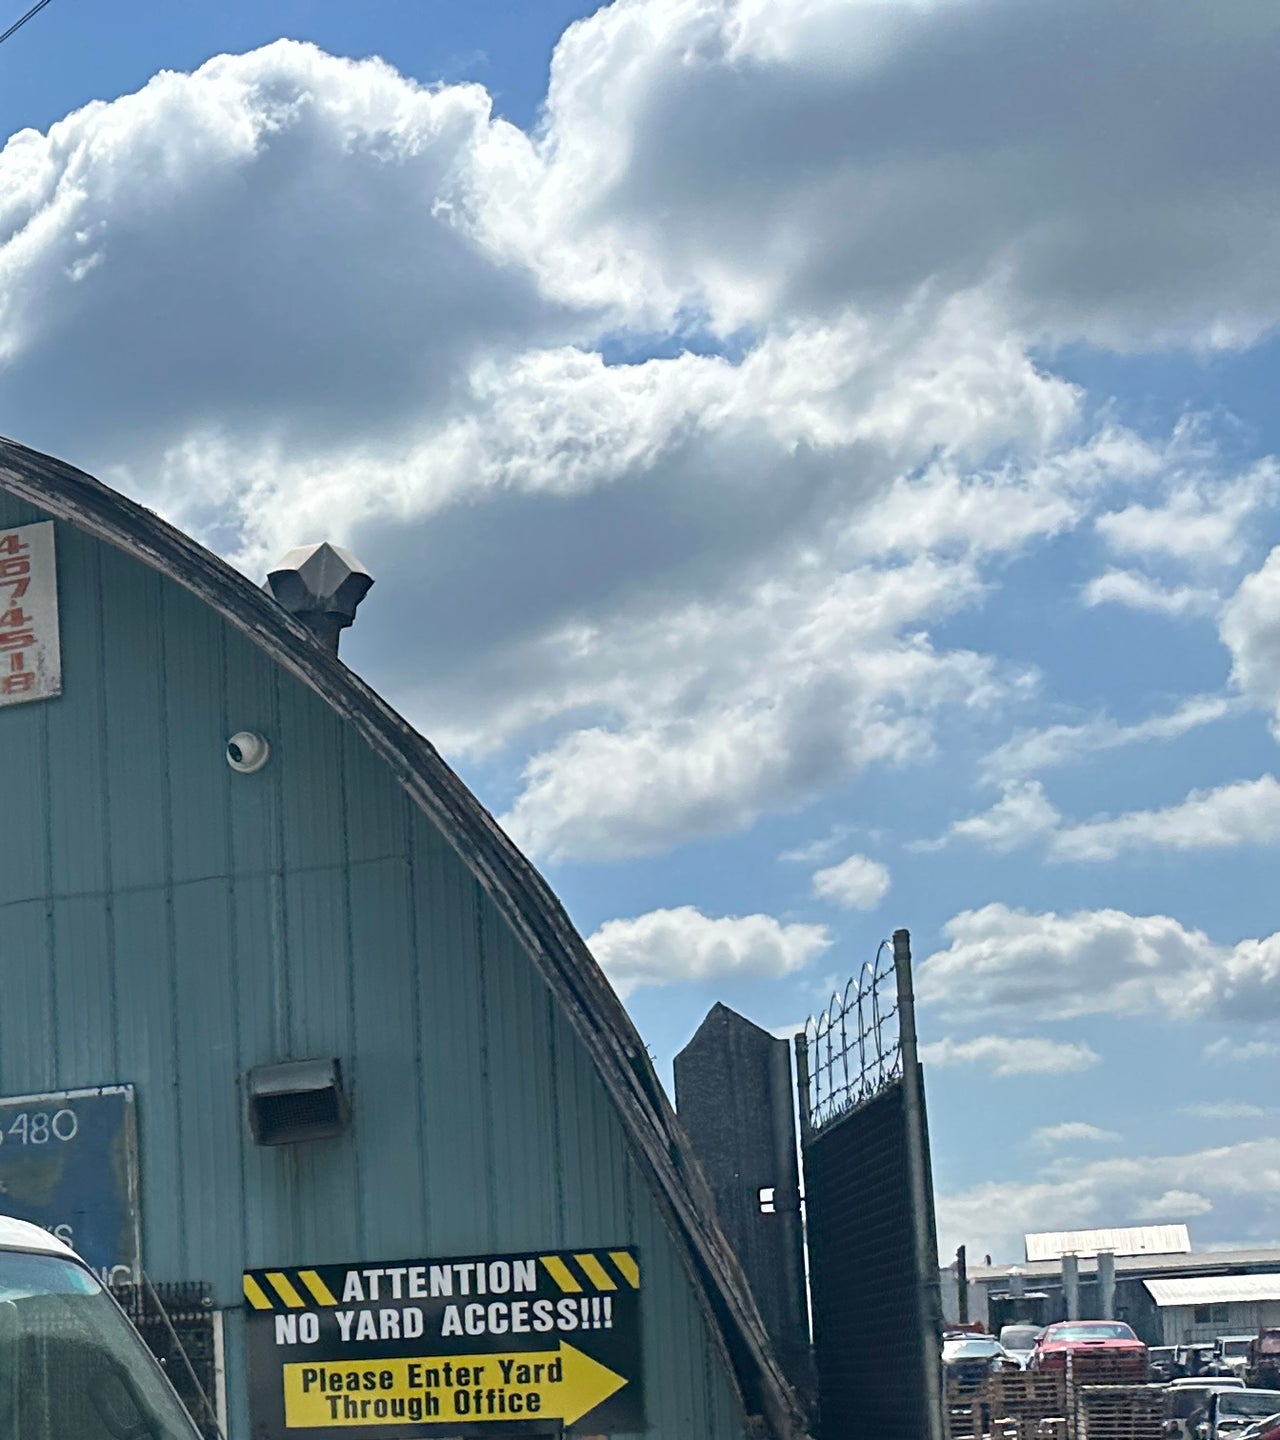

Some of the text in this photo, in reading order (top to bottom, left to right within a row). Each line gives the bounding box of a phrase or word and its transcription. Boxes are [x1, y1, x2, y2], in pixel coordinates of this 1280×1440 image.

[342, 1259, 537, 1303] ATTENTION
[274, 1296, 613, 1346] NO YARD ACCESS!!!
[301, 1356, 564, 1394] Please Enter Yard
[325, 1389, 542, 1423] Through Office
